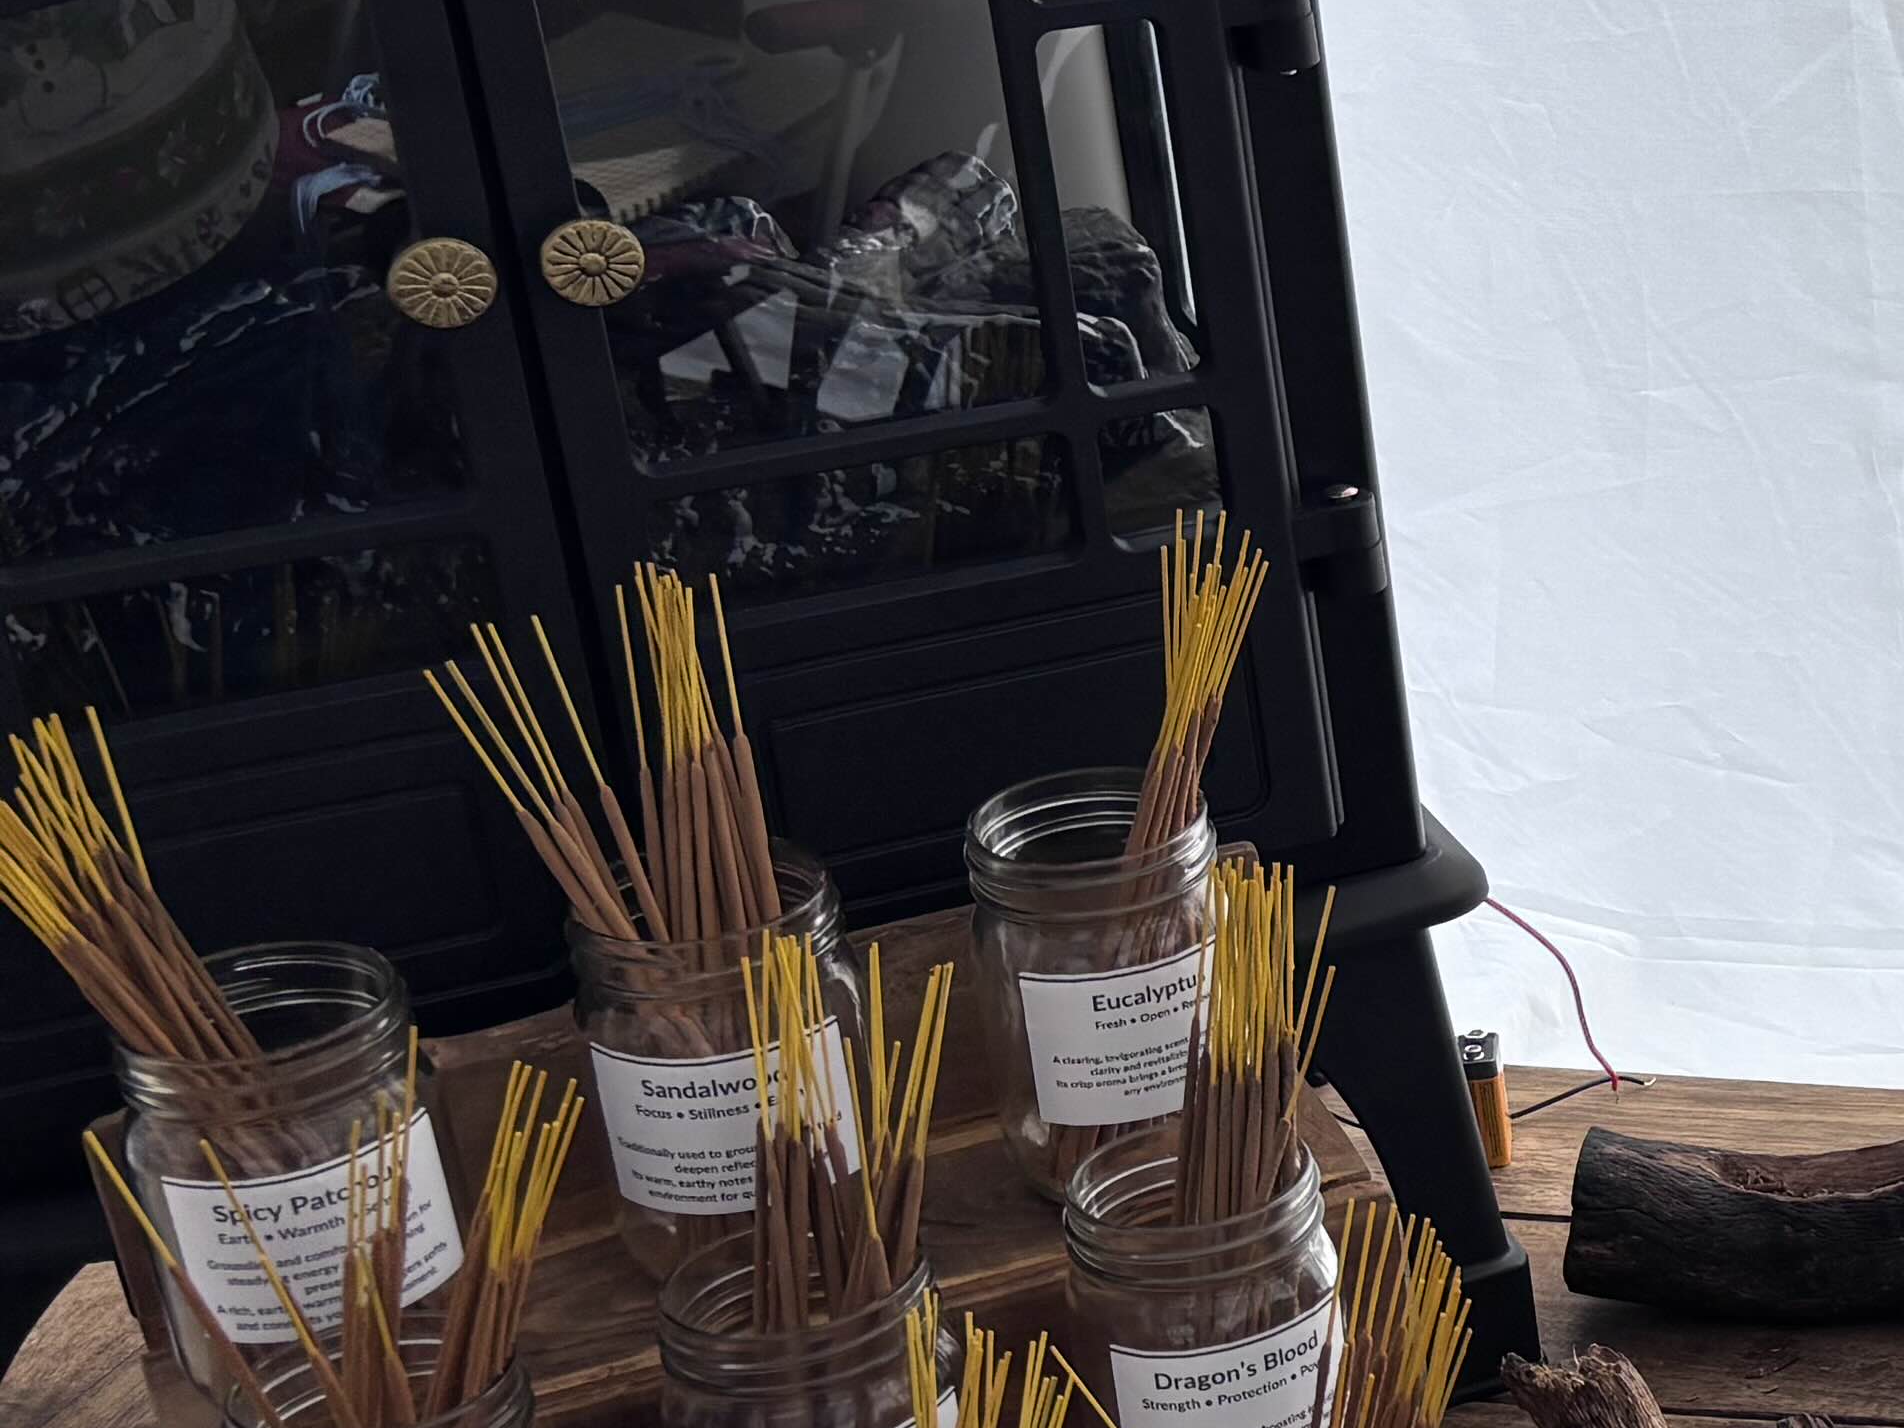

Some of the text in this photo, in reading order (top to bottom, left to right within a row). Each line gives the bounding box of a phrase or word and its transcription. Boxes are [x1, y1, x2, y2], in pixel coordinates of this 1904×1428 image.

[1095, 1009, 1170, 1030] Fresh Open
[635, 1104, 749, 1120] Focus Stillness
[278, 1216, 345, 1240] Warmth
[1154, 1329, 1318, 1392] Dragon's Blood
[1142, 1377, 1288, 1414] Strength Protection
